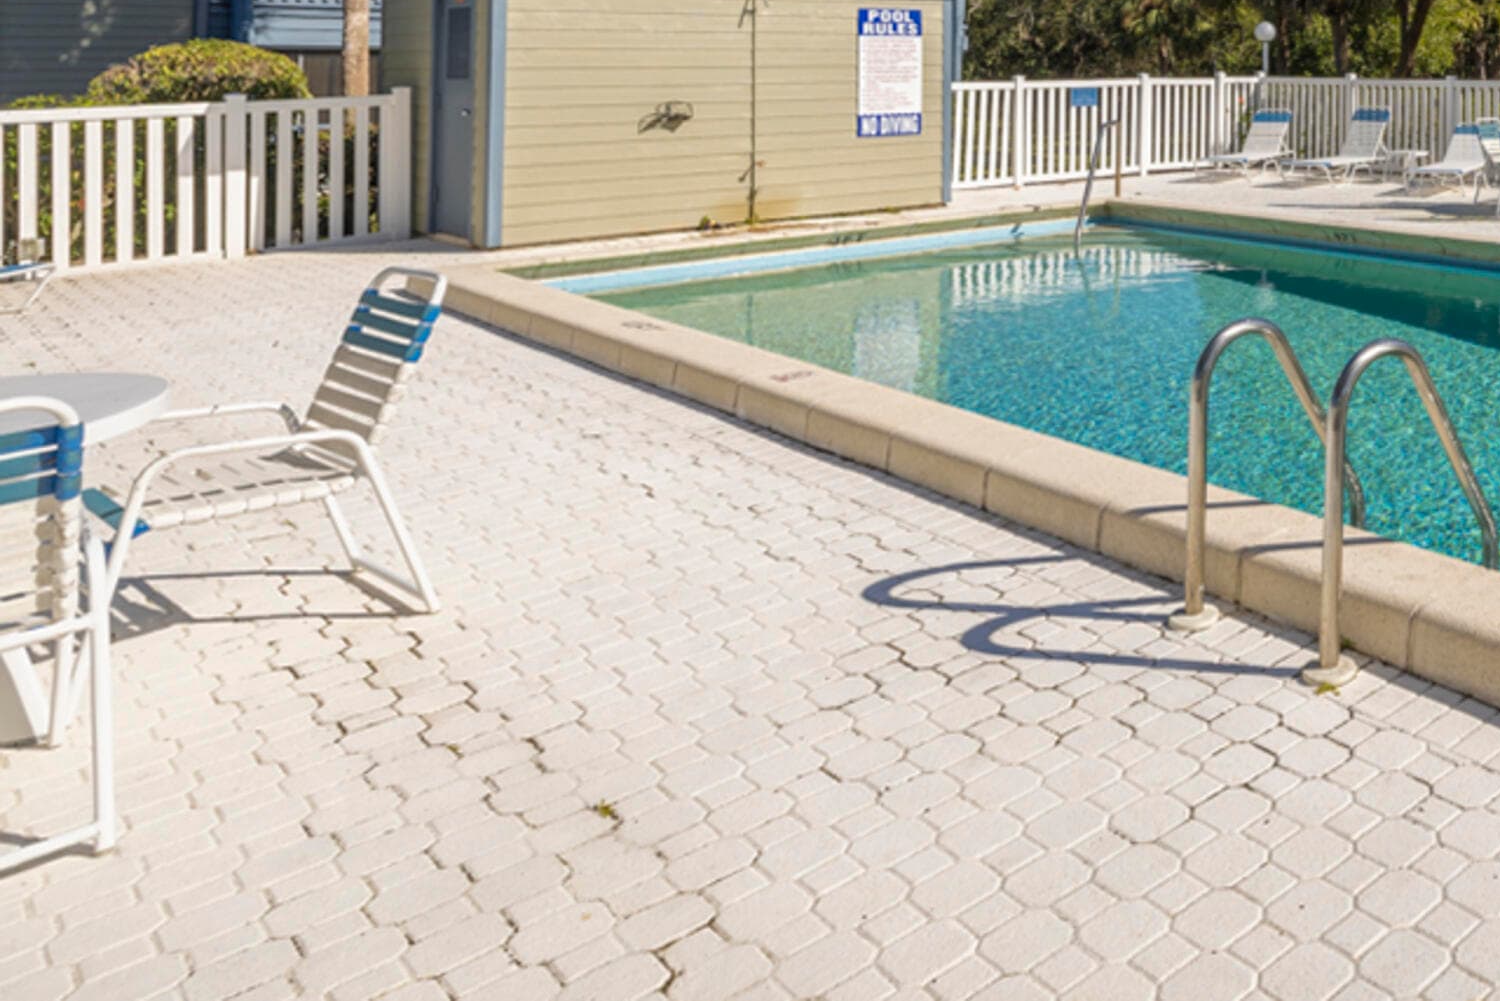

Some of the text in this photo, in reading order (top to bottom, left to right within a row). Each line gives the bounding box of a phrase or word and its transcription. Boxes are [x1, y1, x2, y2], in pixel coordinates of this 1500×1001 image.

[867, 8, 913, 22] POOL
[862, 22, 918, 34] RULES
[861, 114, 917, 135] NO DIVING
